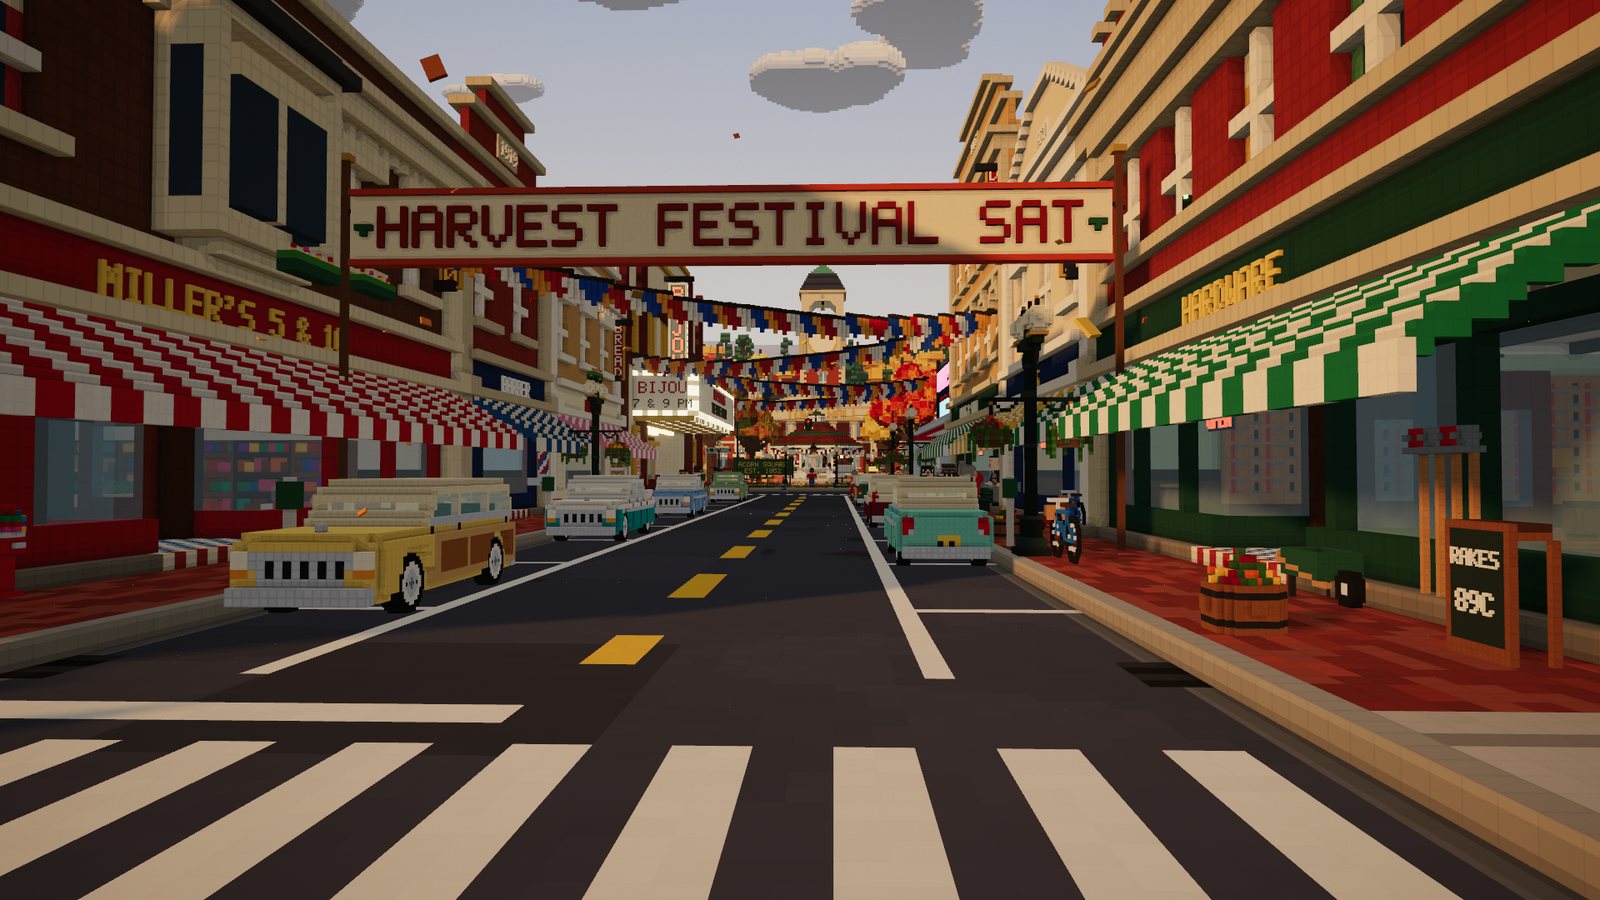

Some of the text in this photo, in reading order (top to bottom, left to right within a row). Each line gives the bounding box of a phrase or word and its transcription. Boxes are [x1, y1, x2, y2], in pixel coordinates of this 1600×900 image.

[376, 199, 1084, 249] HARVEST FESTIVAL SAT
[97, 258, 256, 331] MILLER'S
[268, 308, 286, 339] 5
[296, 316, 311, 346] &
[1182, 249, 1284, 327] HARDWARE
[632, 398, 693, 408] 7 & 9 PM
[637, 381, 687, 394] BIJOU
[1449, 546, 1500, 570] RAKES
